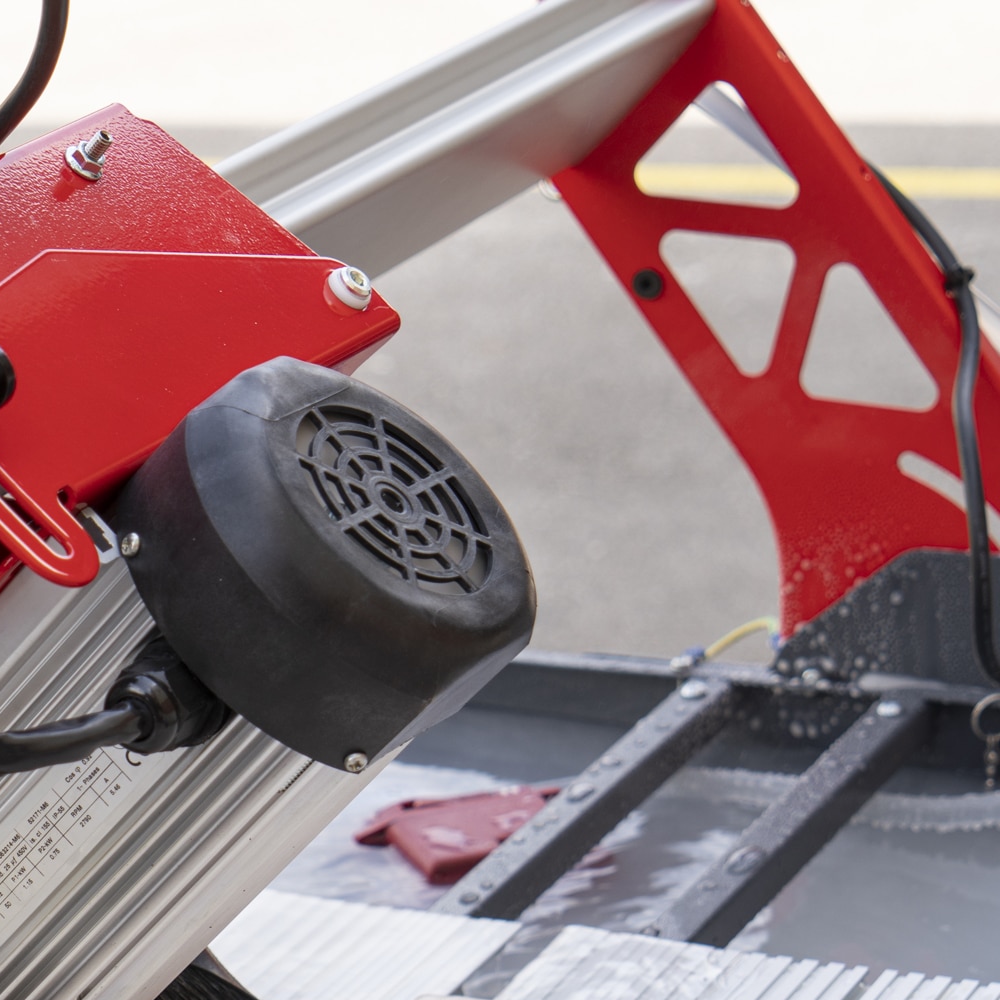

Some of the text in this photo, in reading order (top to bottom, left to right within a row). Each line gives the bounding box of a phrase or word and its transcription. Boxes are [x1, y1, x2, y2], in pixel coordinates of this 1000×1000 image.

[64, 772, 76, 783] Cos
[82, 766, 100, 785] Phases
[52, 805, 65, 820] IP-55
[70, 804, 83, 818] RPM
[41, 821, 50, 831] 155
[37, 837, 53, 854] P2-kW
[49, 848, 60, 860] 0.75
[3, 863, 11, 871] 25
[4, 901, 12, 909] 50
